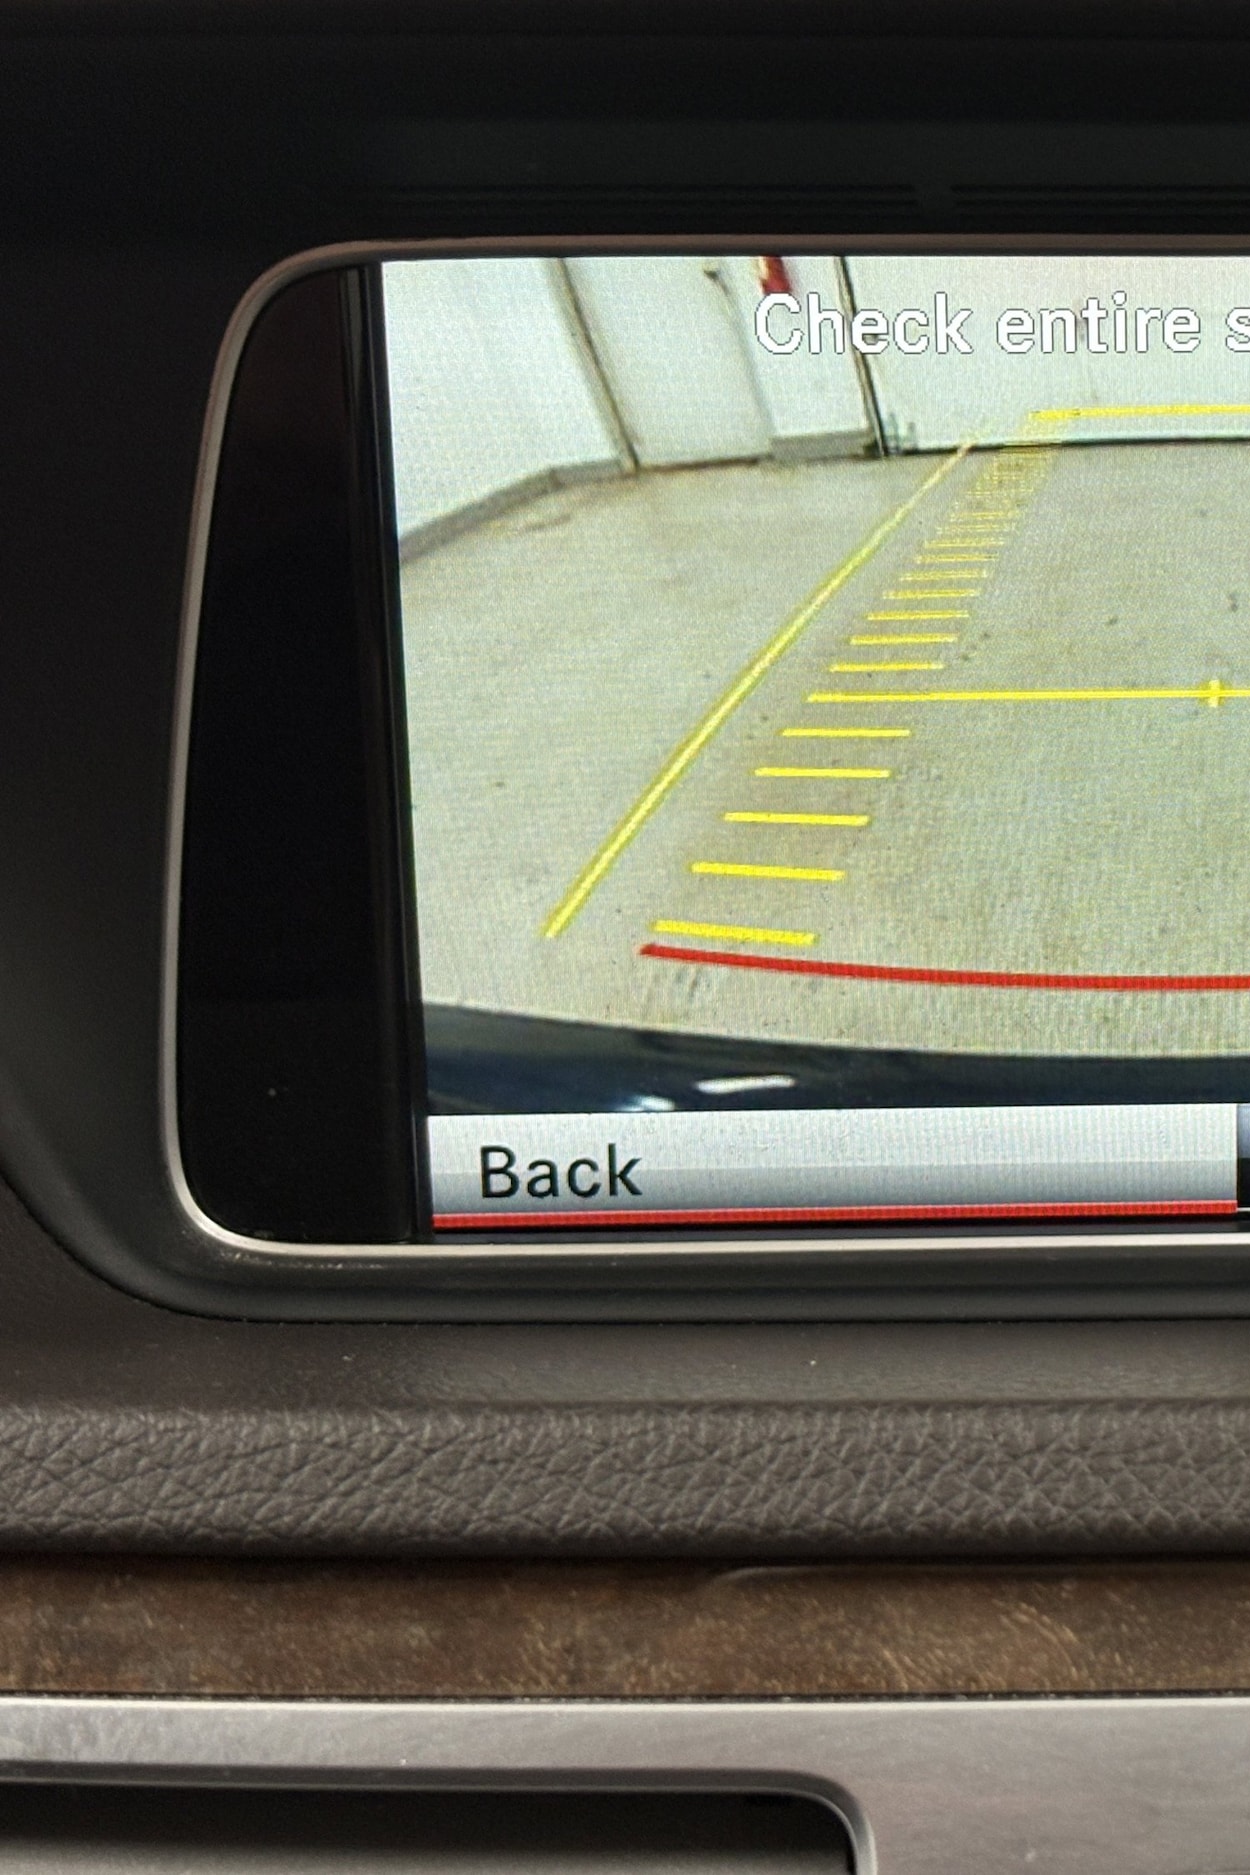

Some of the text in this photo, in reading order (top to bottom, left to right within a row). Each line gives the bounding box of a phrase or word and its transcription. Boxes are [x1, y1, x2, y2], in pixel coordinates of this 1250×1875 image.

[755, 291, 974, 355] Check
[996, 290, 1201, 355] entire
[480, 1143, 643, 1199] Back
